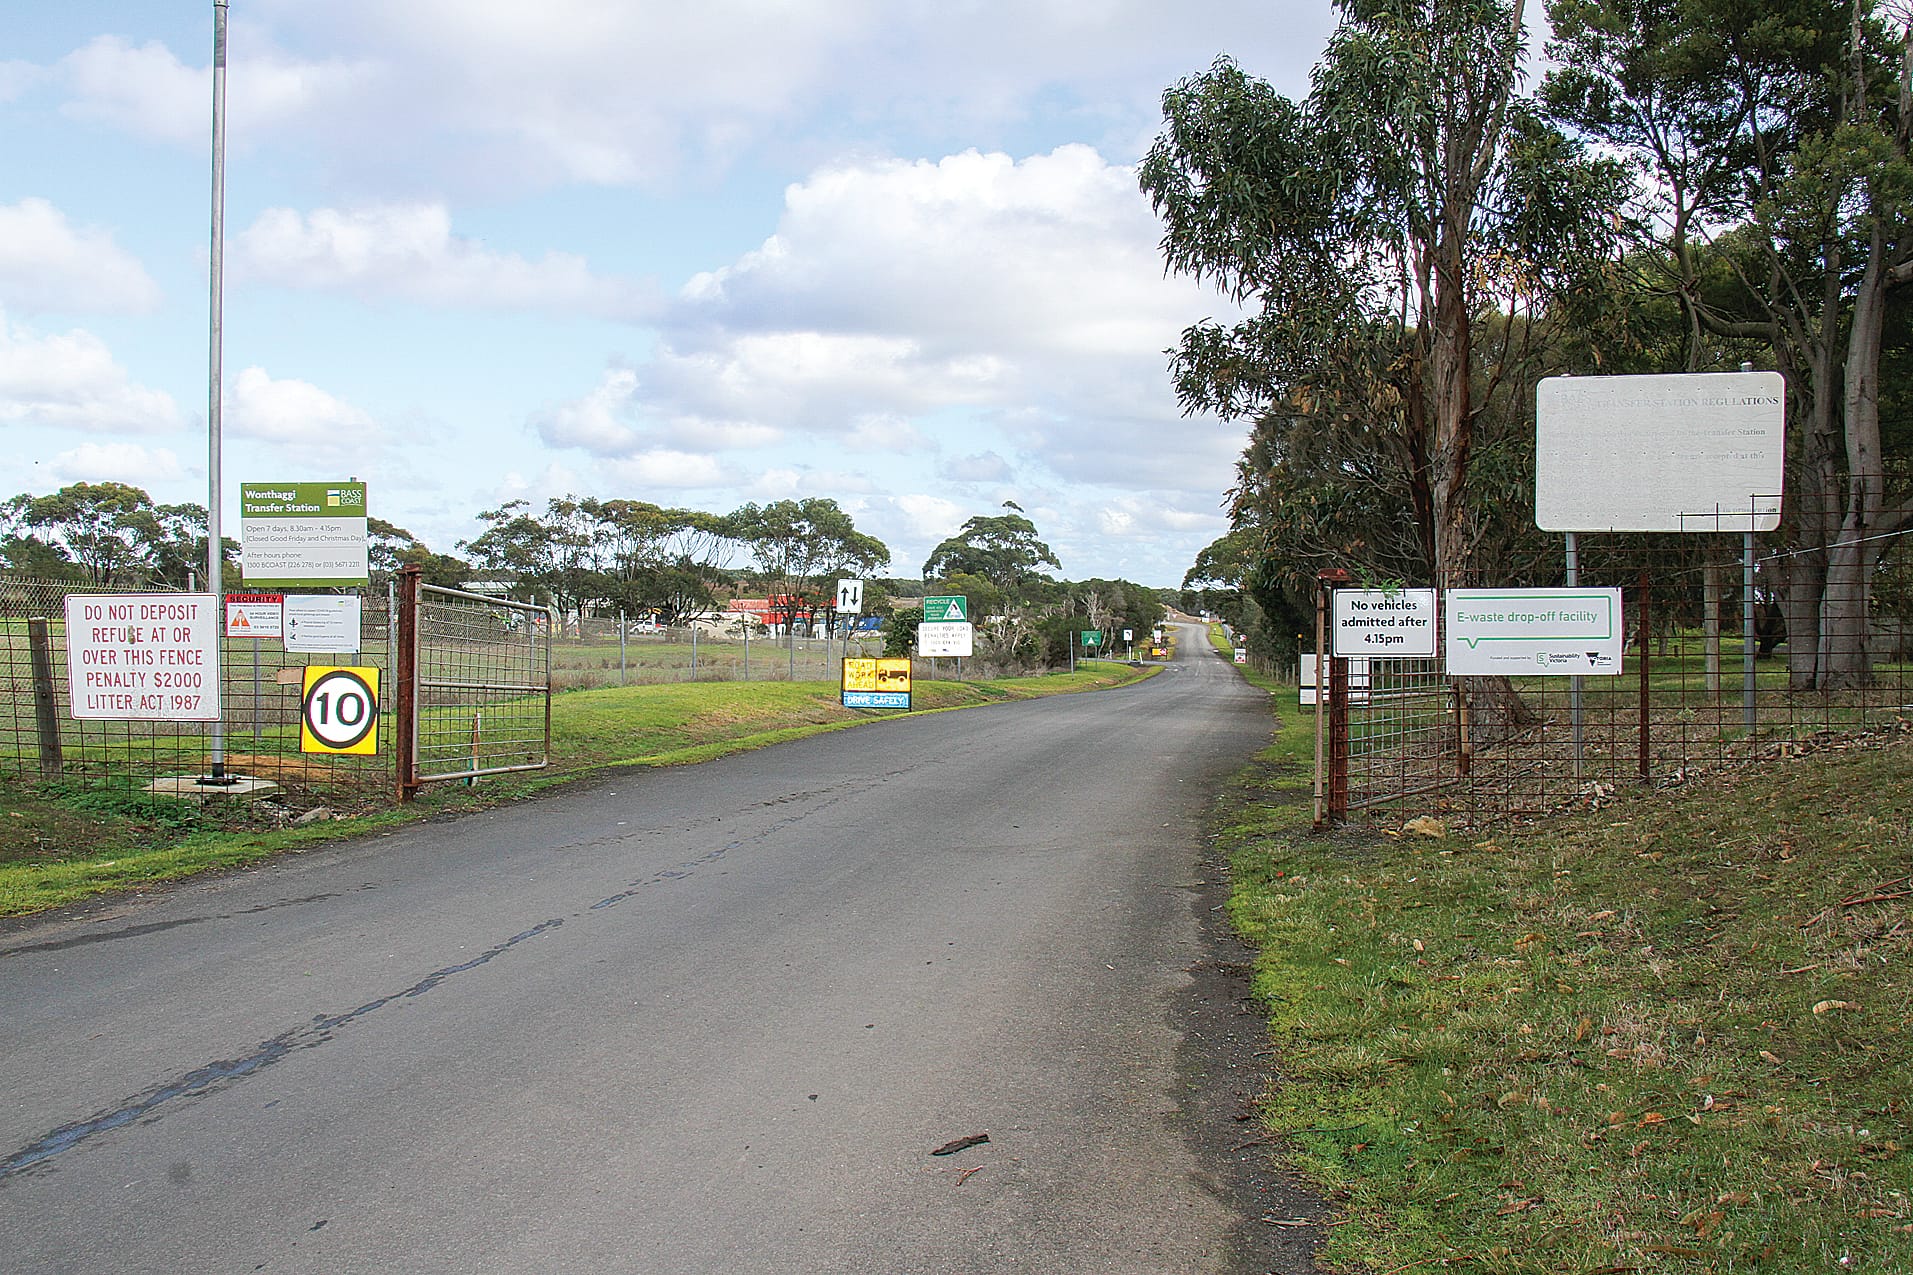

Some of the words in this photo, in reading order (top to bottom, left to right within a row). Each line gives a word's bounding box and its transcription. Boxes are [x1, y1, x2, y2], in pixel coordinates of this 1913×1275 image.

[1652, 399, 1698, 407] STATION
[1702, 397, 1779, 407] REGULATIONS
[1738, 428, 1766, 436] Station
[245, 490, 296, 501] Wonthaggi
[341, 490, 362, 498] BASS
[245, 503, 284, 512] Transfer
[286, 504, 320, 512] Station
[1351, 600, 1368, 610] No
[1371, 599, 1418, 610] vehicles
[85, 605, 102, 621] DO
[109, 605, 134, 620] NOT
[141, 604, 198, 620] DEPOSIT
[1457, 612, 1504, 622] E-waste
[1507, 611, 1556, 624] drop-off
[1559, 610, 1598, 623] facility
[1341, 616, 1395, 627] admitted
[1398, 615, 1428, 626] after
[151, 627, 167, 643] AT
[173, 627, 191, 643] OR
[1364, 633, 1404, 646] 4.15pm
[82, 649, 117, 665] OVER
[123, 650, 154, 665] THIS
[160, 649, 203, 665] FENCE
[848, 661, 873, 669] ROAD
[86, 672, 146, 687] PENALTY
[154, 672, 202, 688] $2000
[848, 671, 874, 679] WORK
[87, 694, 133, 710] LITTER
[139, 694, 164, 710] ACT
[170, 695, 201, 710] 1987
[847, 695, 871, 704] DRIVE
[873, 695, 905, 705] SAFELY
[316, 692, 364, 726] 10
